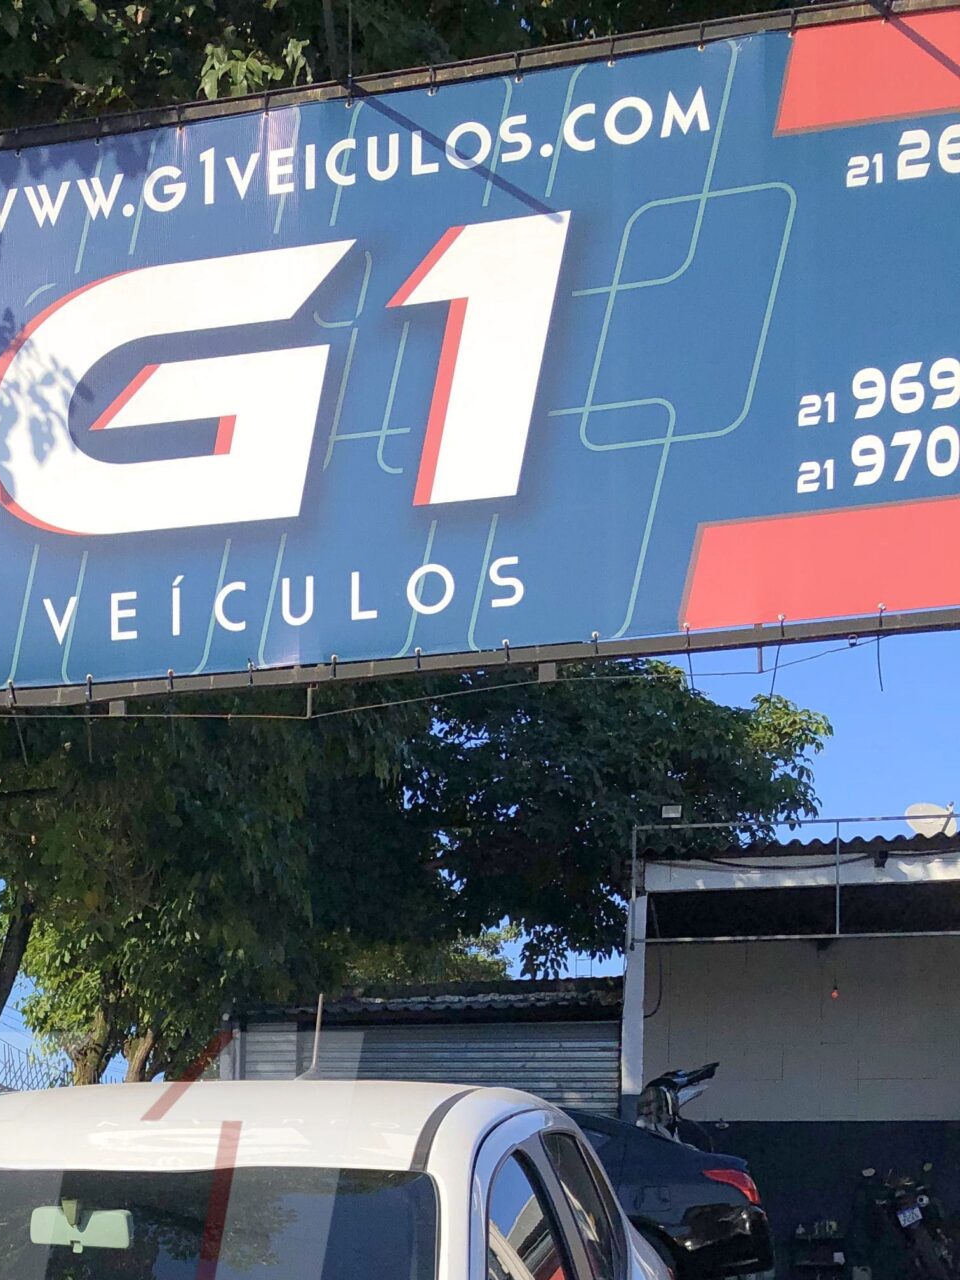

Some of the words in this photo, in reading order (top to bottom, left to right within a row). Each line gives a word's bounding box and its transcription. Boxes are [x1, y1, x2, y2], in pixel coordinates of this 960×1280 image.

[846, 153, 884, 188] 21
[798, 392, 836, 427] 21
[852, 357, 960, 419] 969
[797, 459, 835, 494] 21
[850, 425, 960, 486] 970
[43, 556, 525, 645] VEÍCULOS
